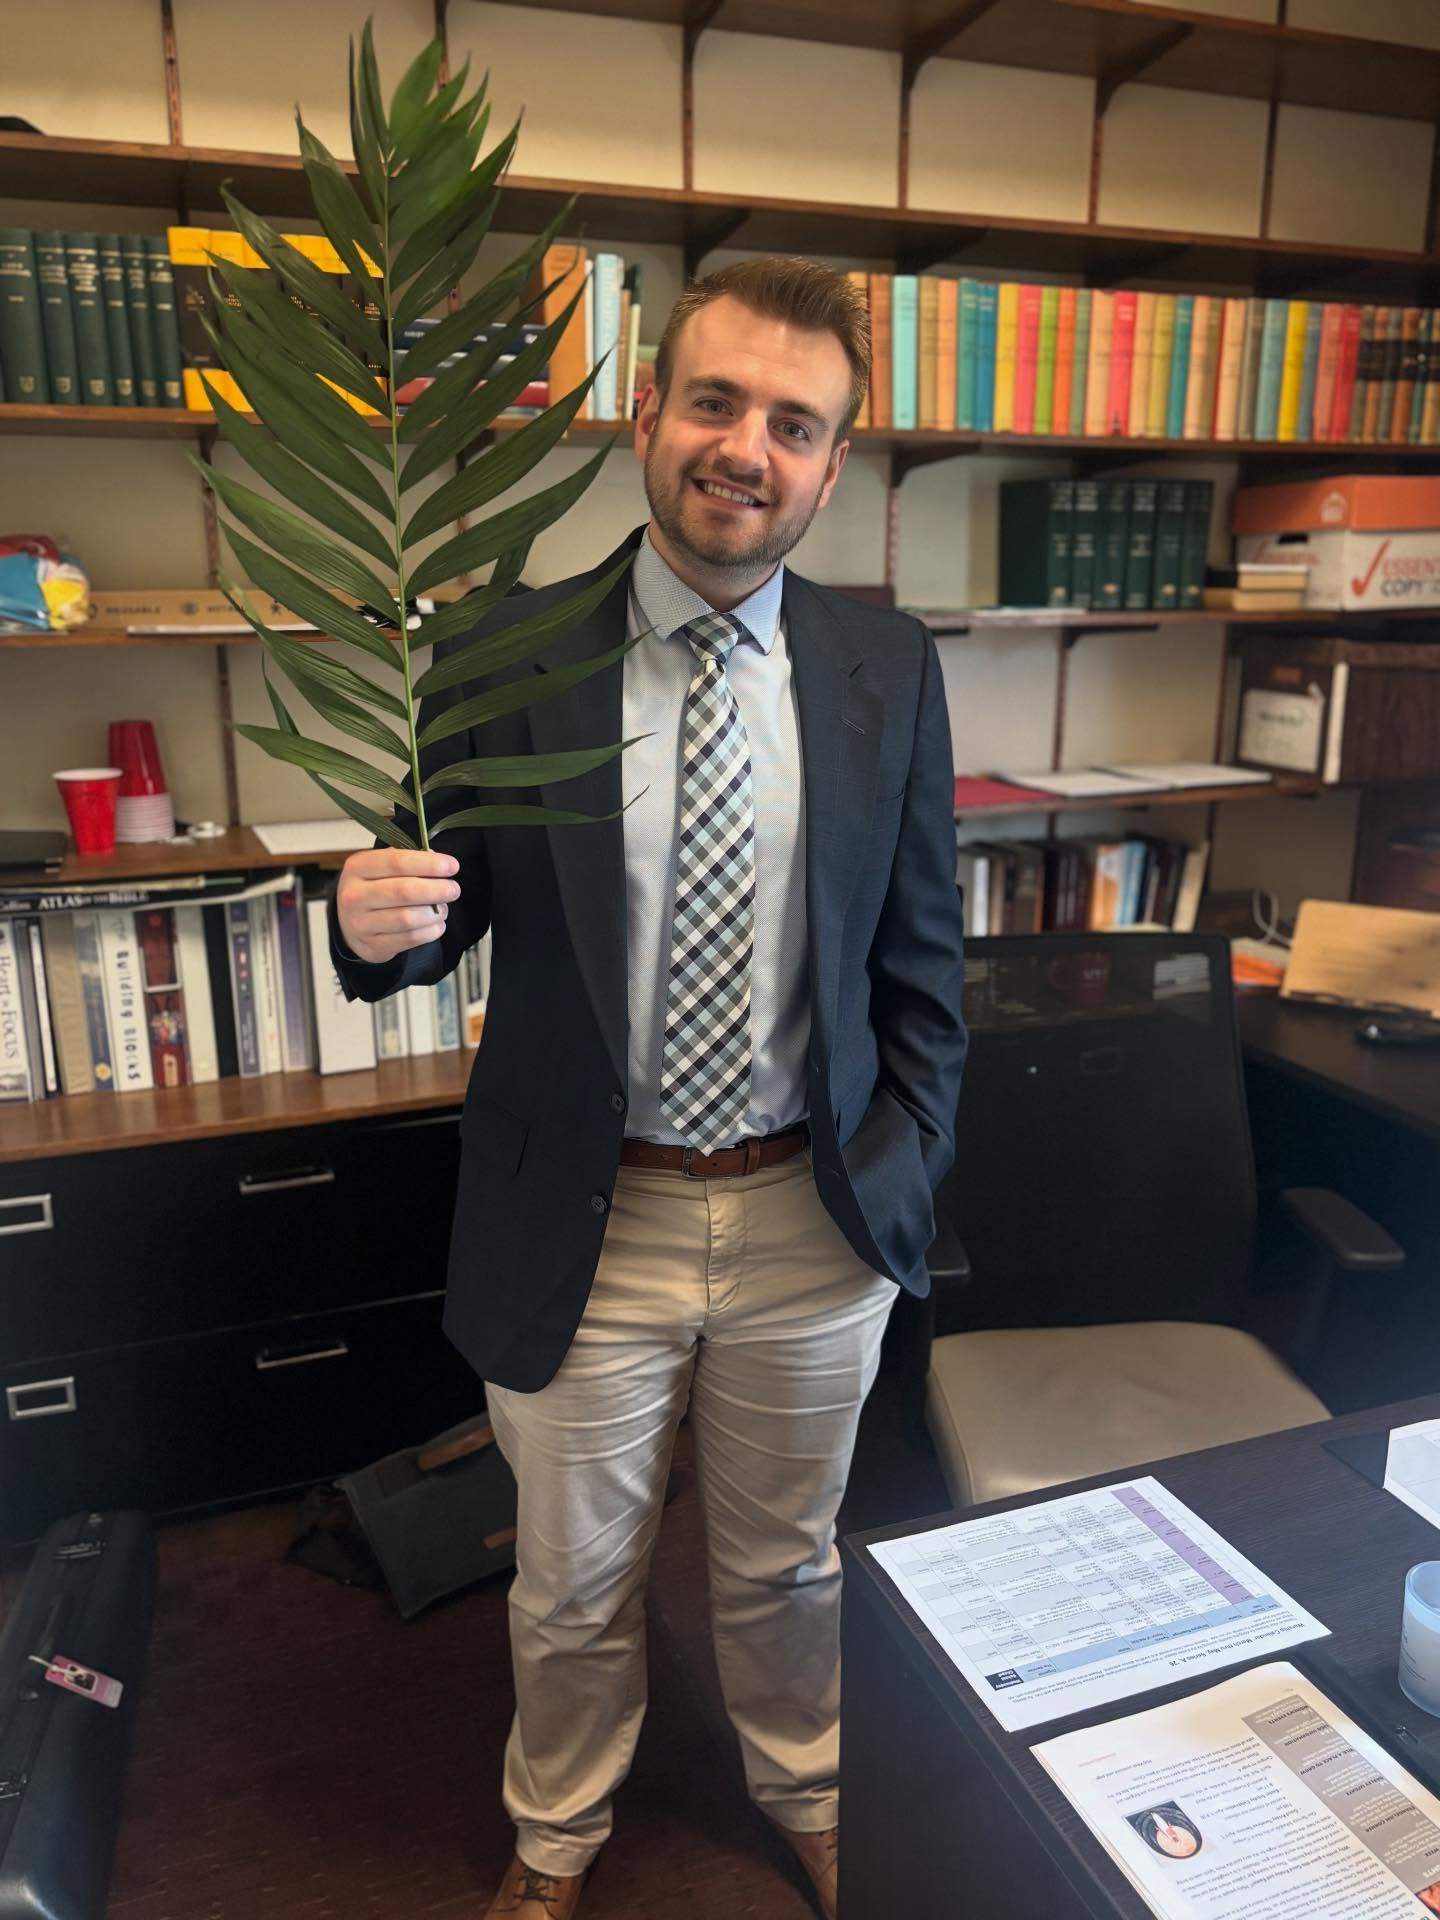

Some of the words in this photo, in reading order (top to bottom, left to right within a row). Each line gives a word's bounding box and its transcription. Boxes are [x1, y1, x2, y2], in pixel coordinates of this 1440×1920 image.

[1383, 557, 1440, 577] ESSEN
[38, 894, 84, 909] ATLAS
[1231, 1637, 1253, 1647] March
